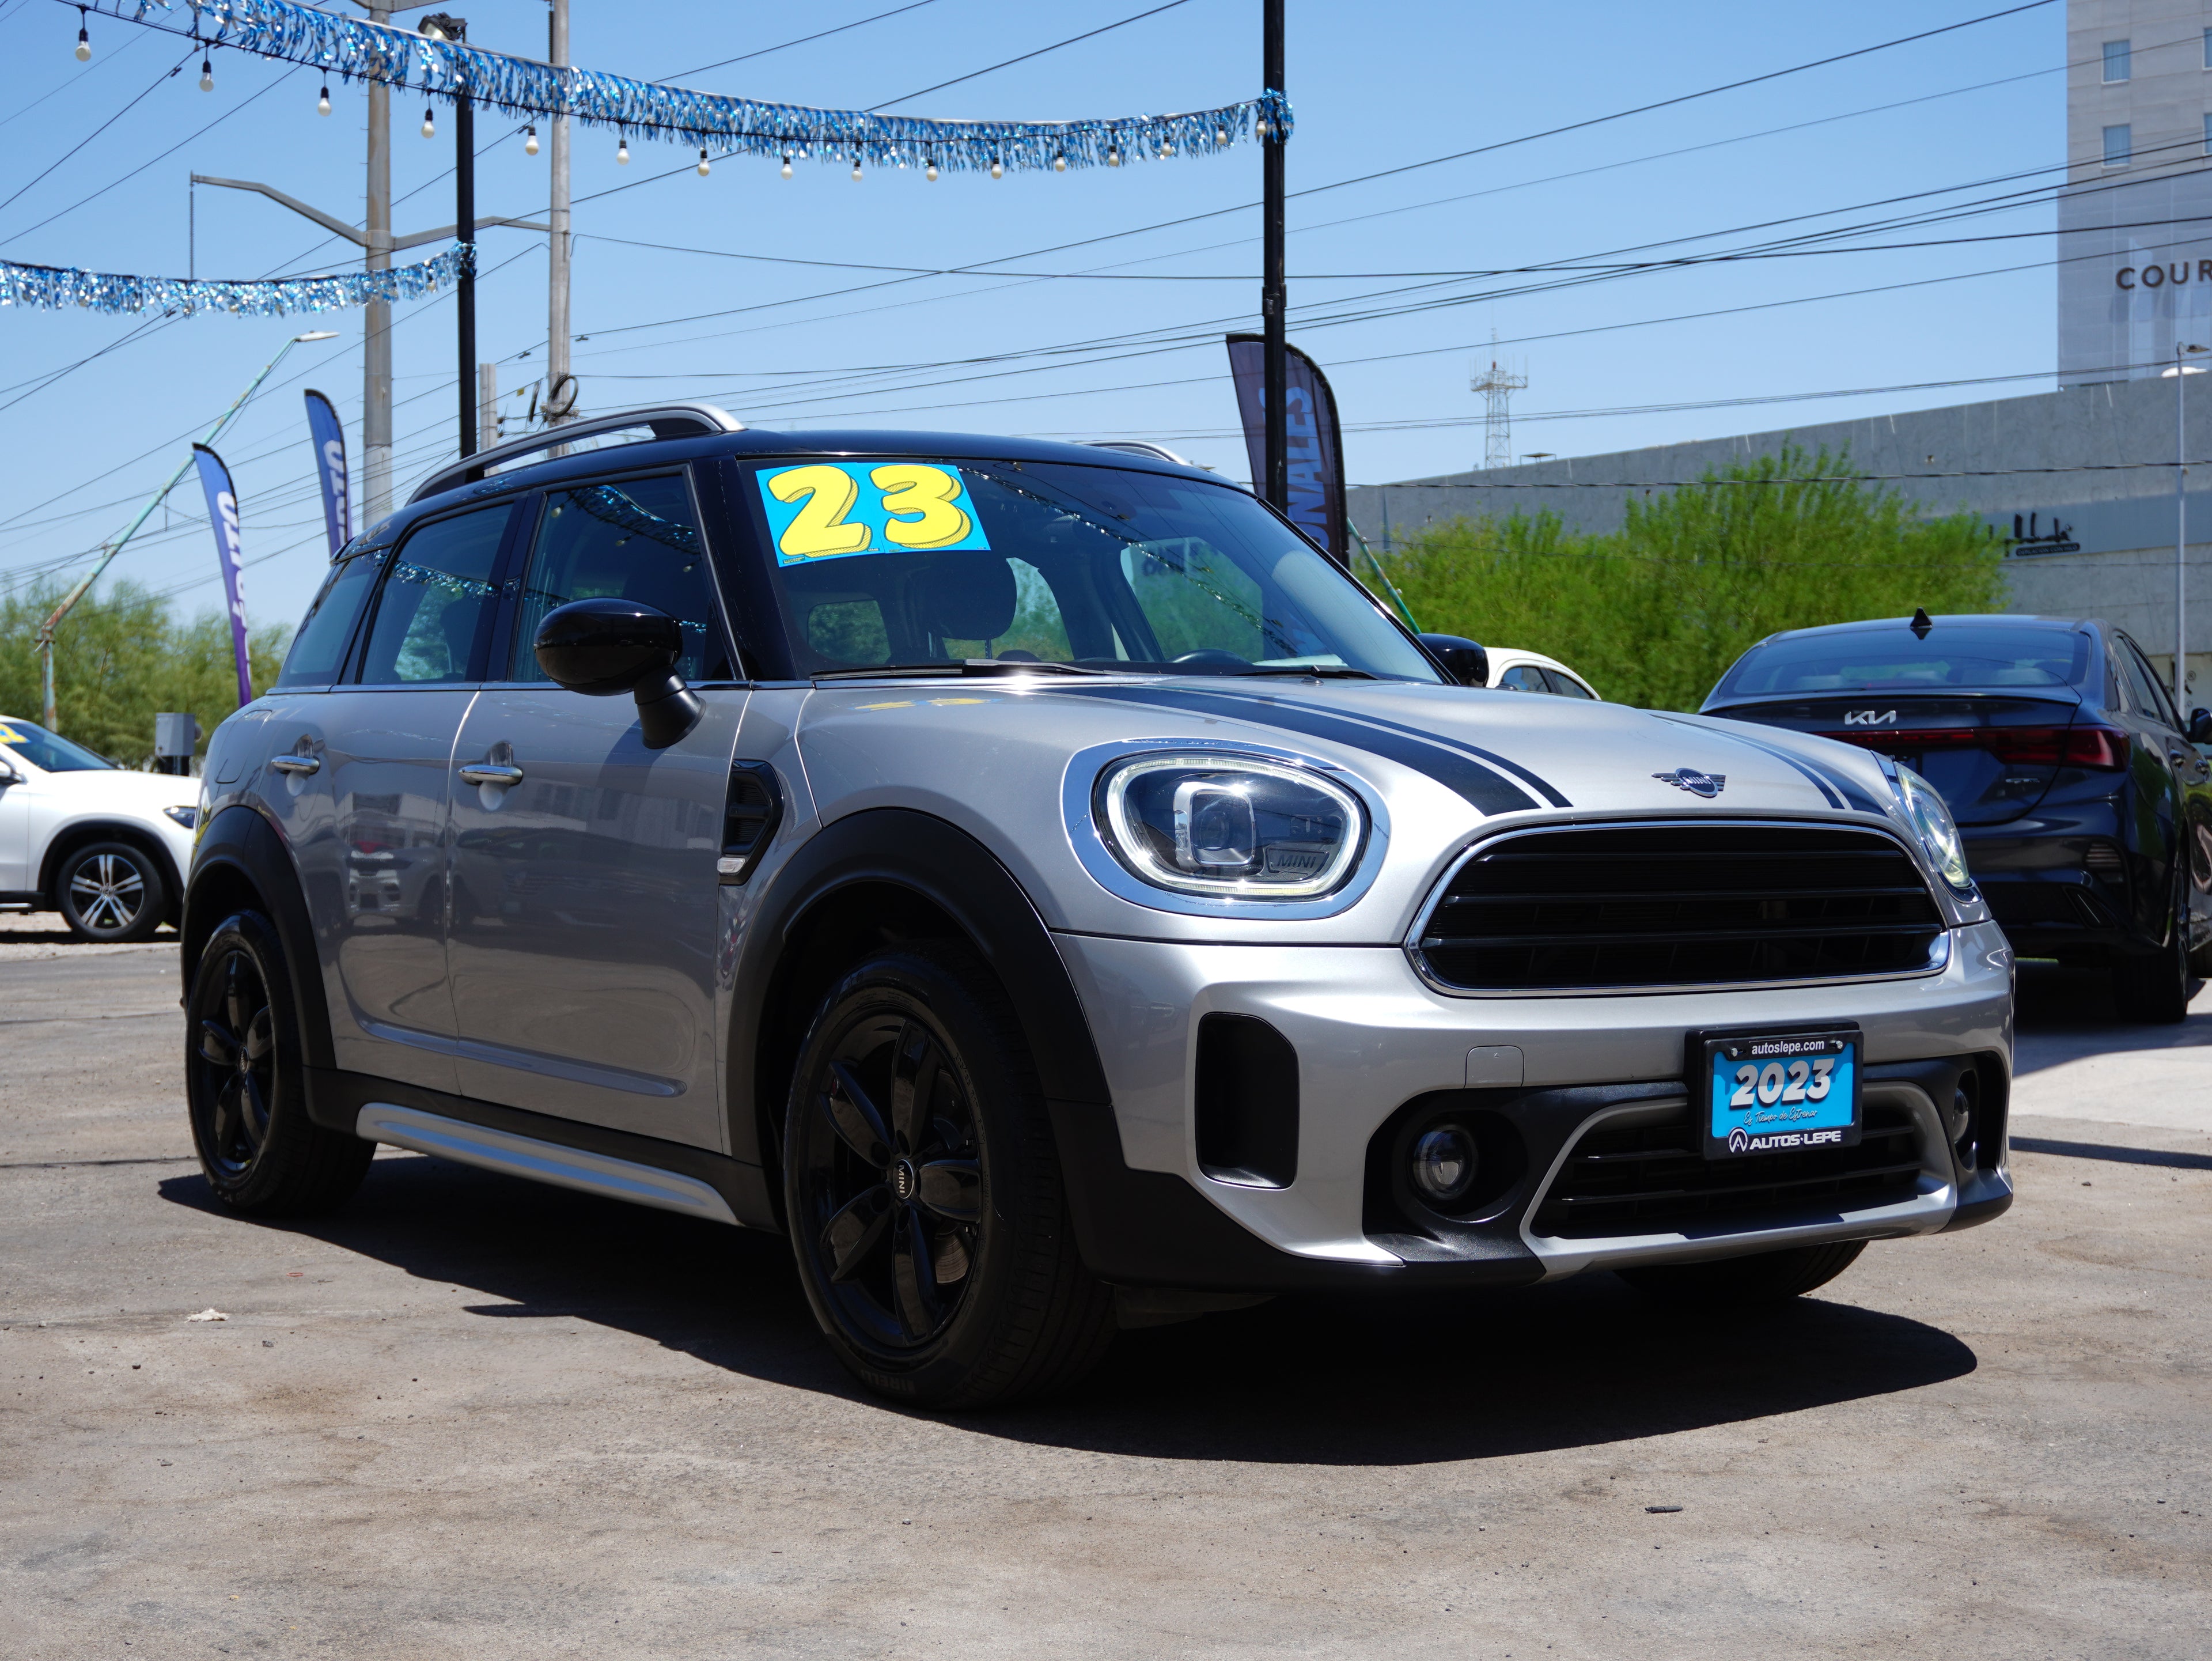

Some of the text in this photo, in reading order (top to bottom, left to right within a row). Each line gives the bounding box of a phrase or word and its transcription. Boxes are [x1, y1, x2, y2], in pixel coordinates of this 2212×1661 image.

[767, 464, 974, 558] 23
[1844, 710, 1896, 725] KIA
[1277, 854, 1317, 868] MINI
[1752, 1041, 1825, 1054] autoslepe.com
[1730, 1058, 1835, 1107] 2023
[1744, 1106, 1818, 1125] Es Tiempo de Estrenar
